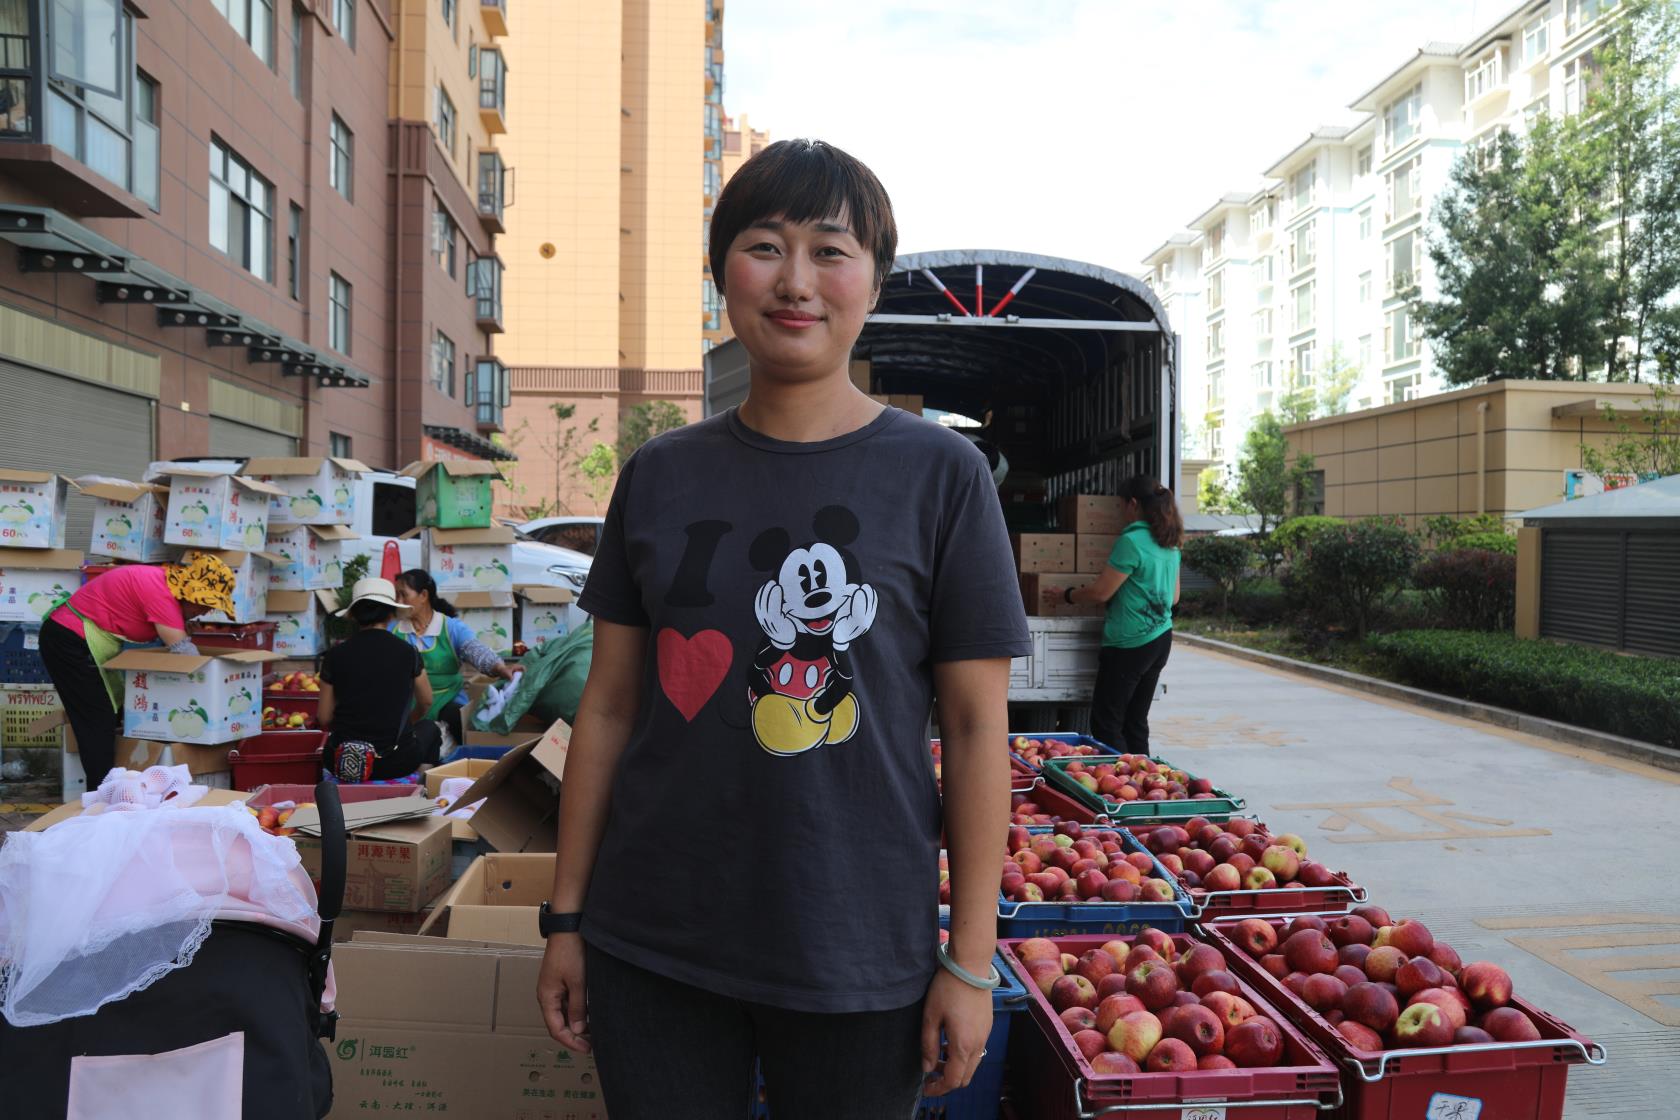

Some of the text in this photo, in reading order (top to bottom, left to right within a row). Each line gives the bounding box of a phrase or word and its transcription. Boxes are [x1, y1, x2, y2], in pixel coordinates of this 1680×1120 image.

[2, 528, 16, 538] 60
[106, 541, 117, 551] 60
[663, 519, 733, 608] I
[276, 641, 287, 649] 60
[230, 722, 240, 733] 60
[370, 1045, 409, 1059] 洱园红
